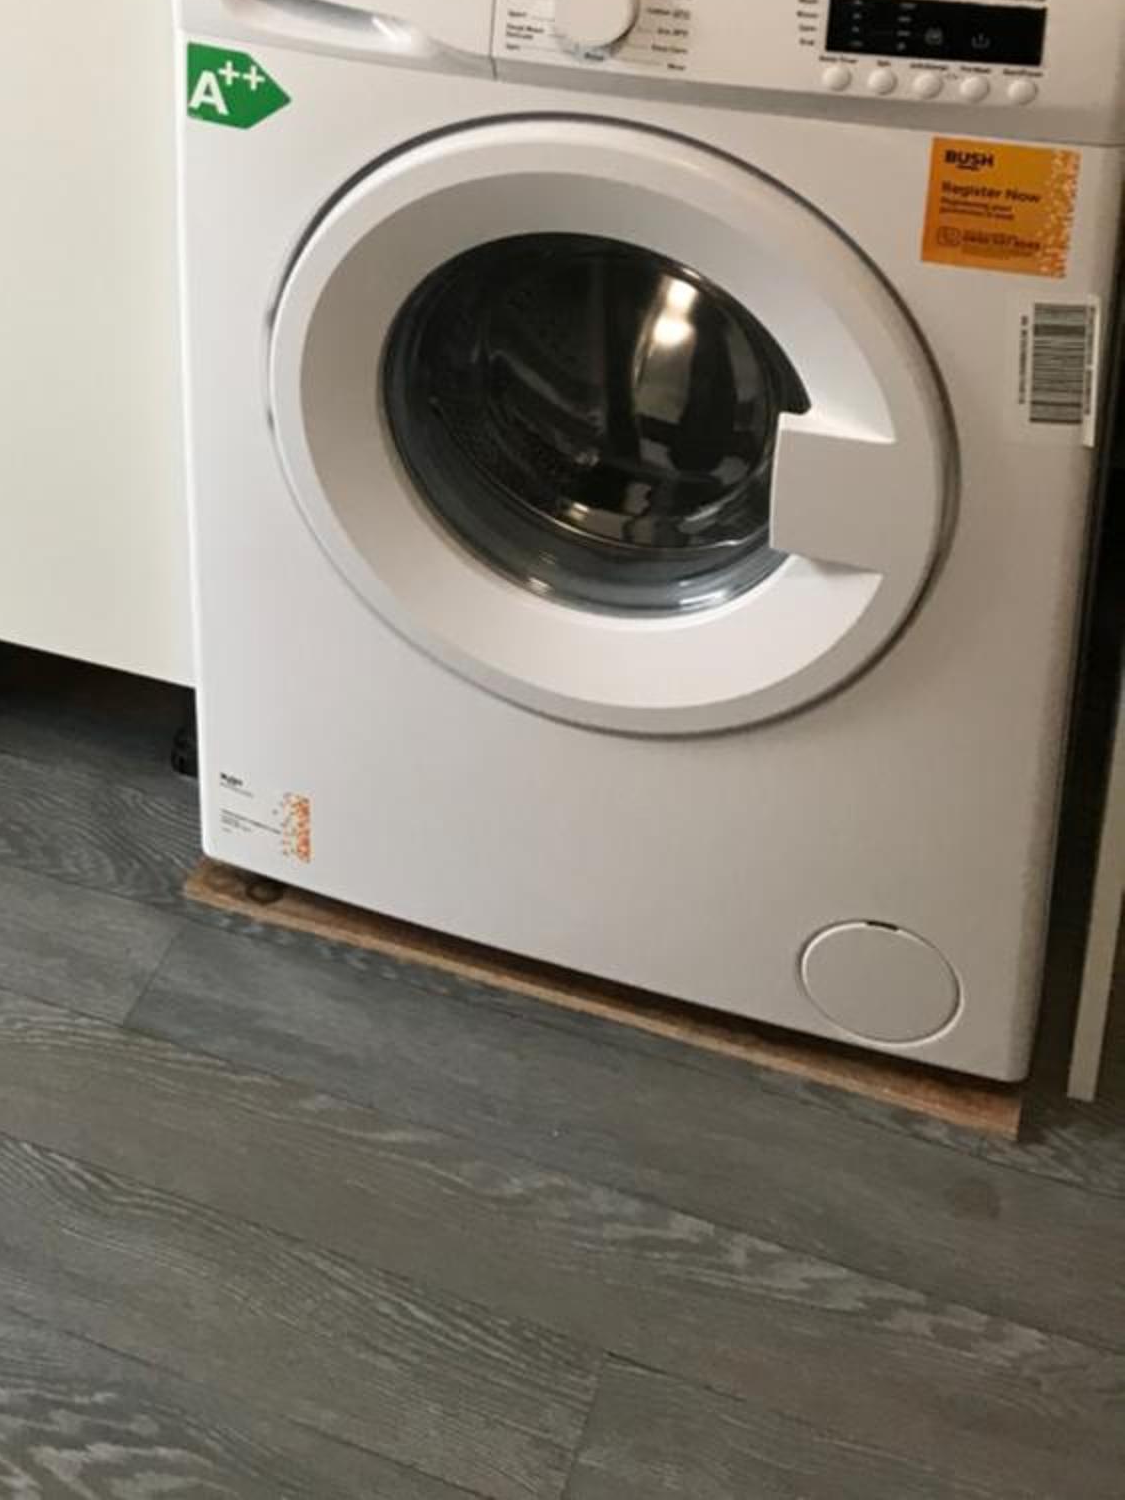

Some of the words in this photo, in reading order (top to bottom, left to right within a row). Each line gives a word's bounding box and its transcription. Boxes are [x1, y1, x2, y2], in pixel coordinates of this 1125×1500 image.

[188, 60, 266, 116] A++
[944, 150, 994, 168] BUSH
[941, 180, 1002, 198] Register
[1005, 189, 1042, 203] Now
